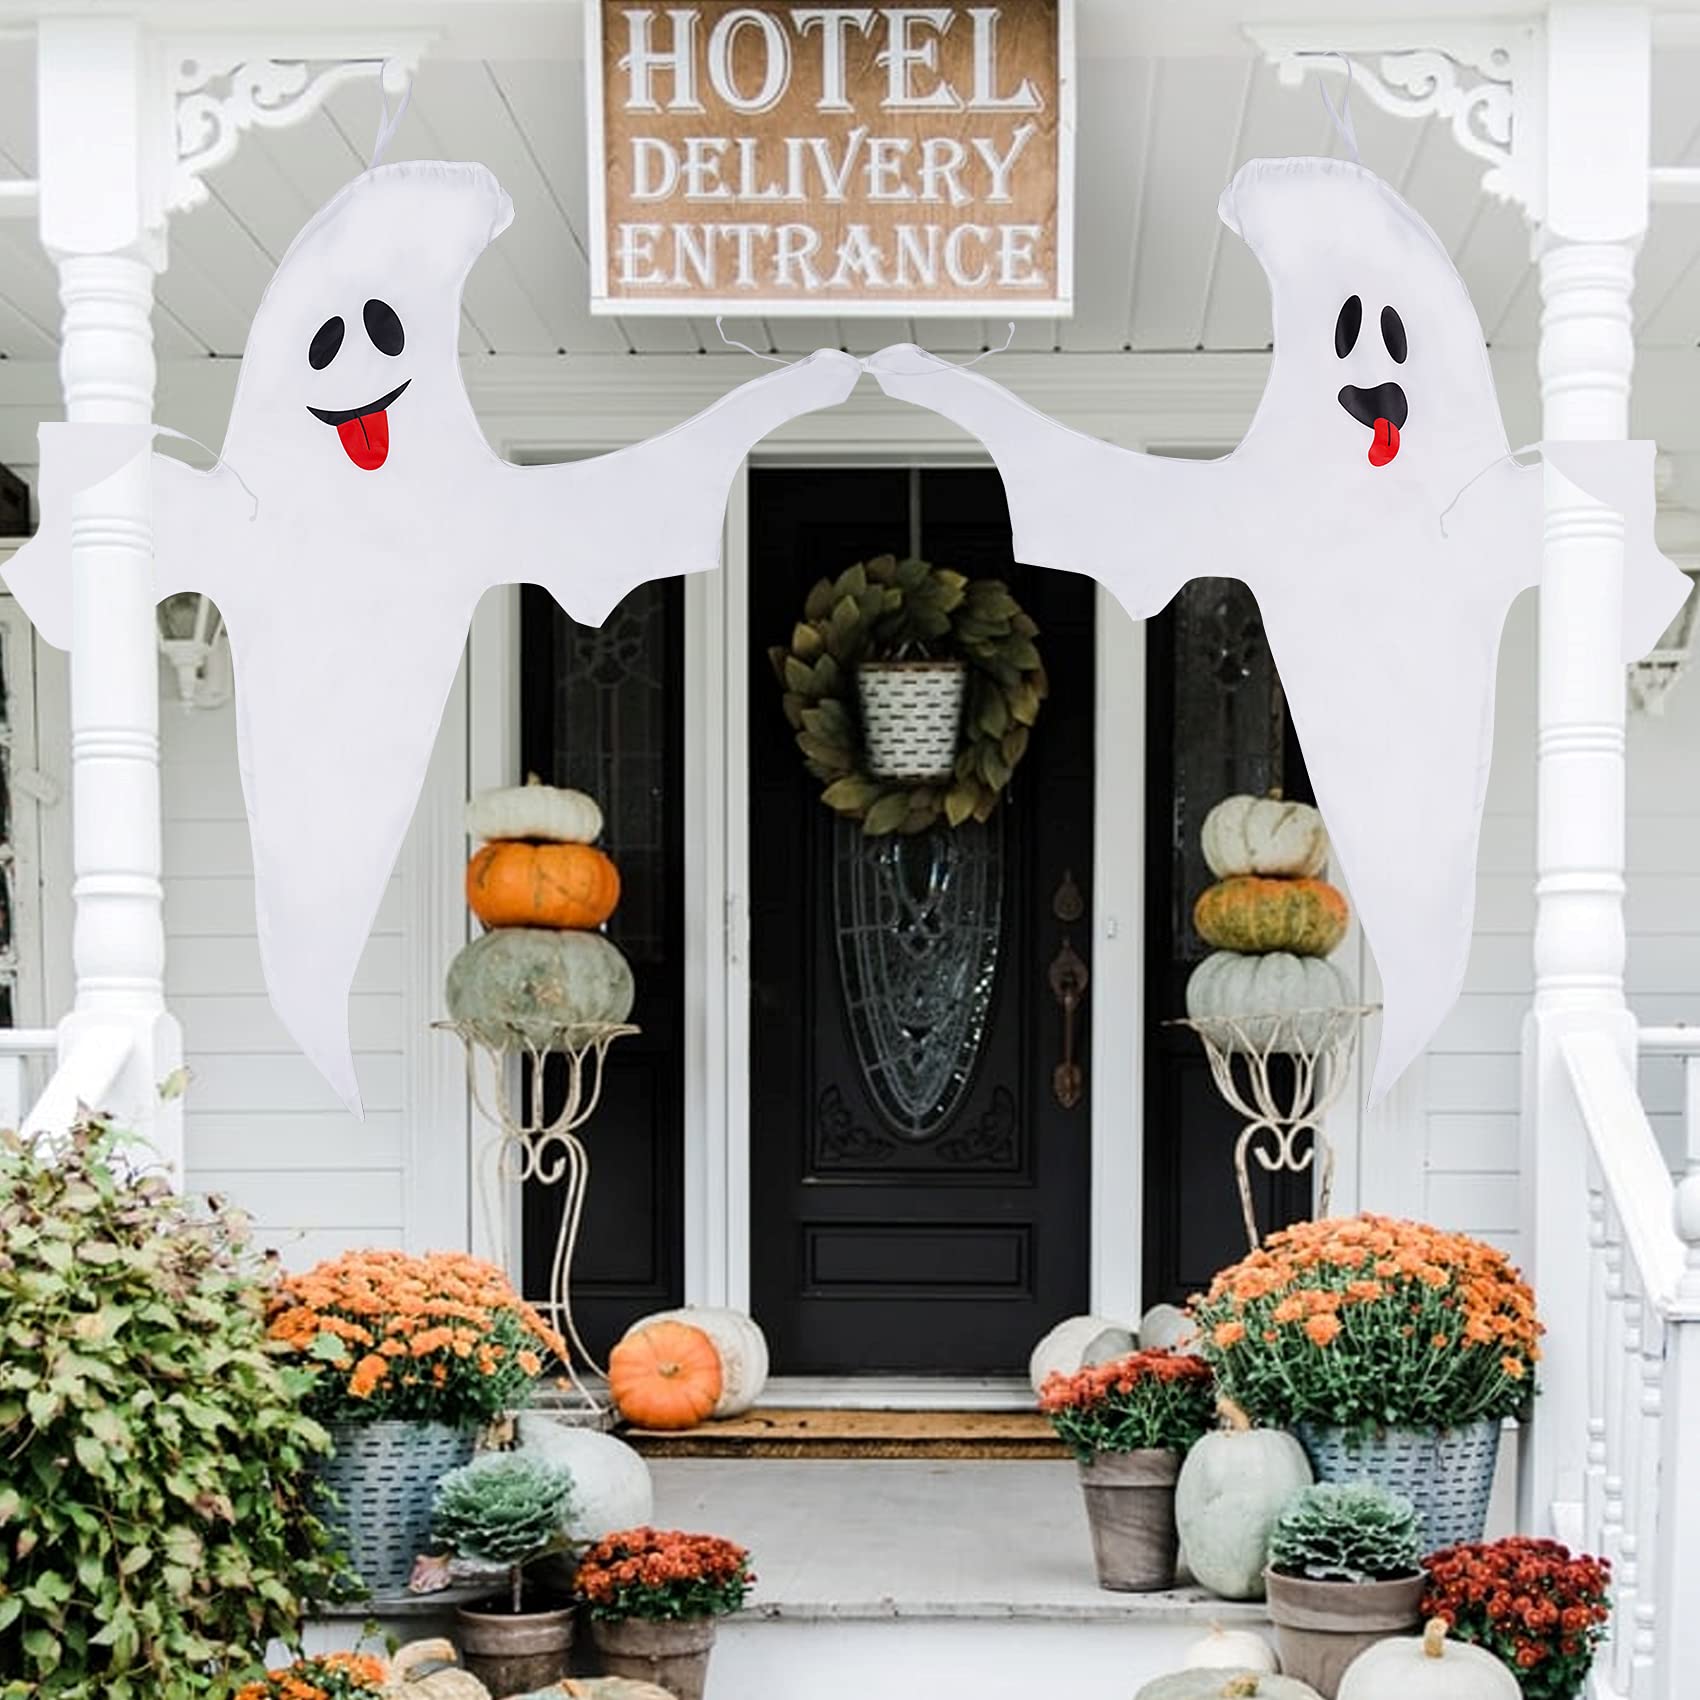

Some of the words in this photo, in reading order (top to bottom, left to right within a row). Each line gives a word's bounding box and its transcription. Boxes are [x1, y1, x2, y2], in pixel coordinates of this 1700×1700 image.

[618, 8, 1044, 114] HOTEL
[630, 123, 1038, 207] DELIVERY
[616, 222, 1045, 291] ENTRANCE
